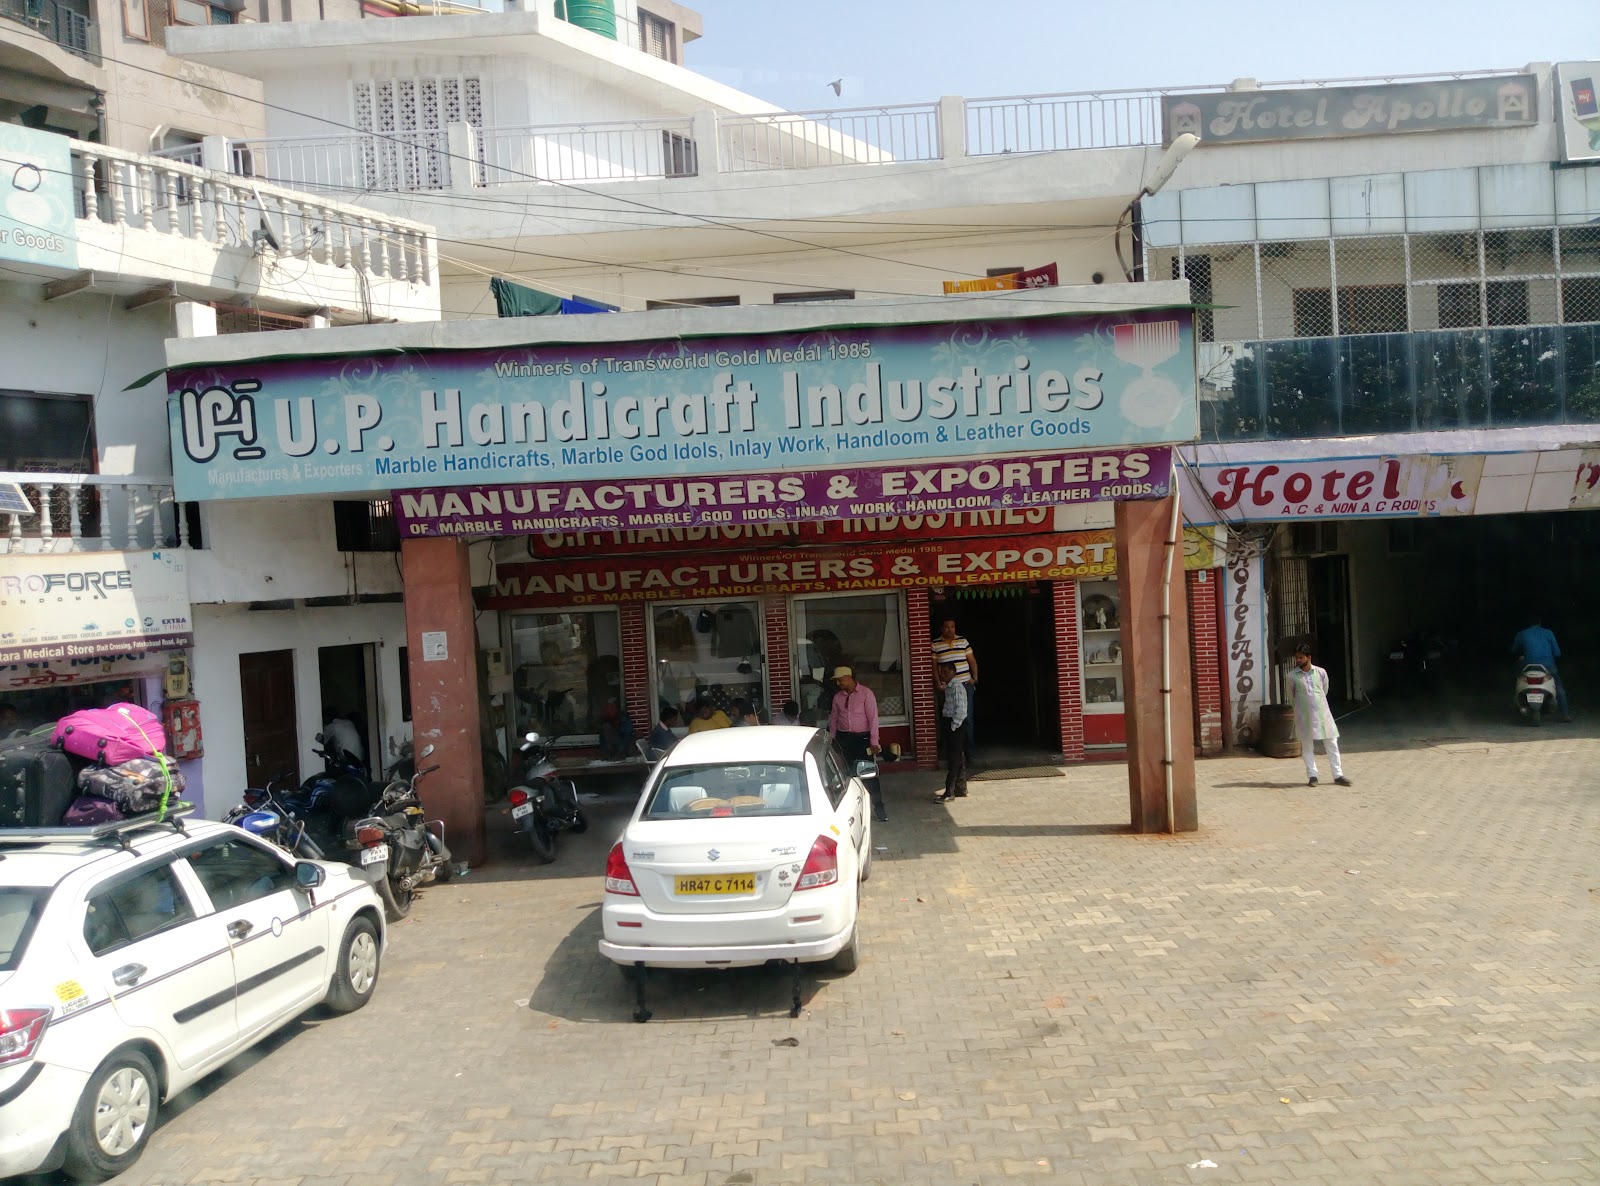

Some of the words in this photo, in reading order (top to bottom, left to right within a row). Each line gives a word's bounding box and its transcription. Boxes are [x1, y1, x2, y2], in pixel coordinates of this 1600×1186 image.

[1210, 96, 1328, 136] Hotel
[1342, 89, 1488, 130] Apollo
[12, 228, 64, 252] Goods
[495, 361, 573, 378] Winners
[580, 359, 599, 374] of
[603, 353, 709, 373] Transworld
[715, 350, 759, 367] Gold
[766, 346, 821, 365] Medal
[827, 342, 872, 360] 1985
[274, 395, 395, 458] U.P.
[421, 372, 758, 449] Handicraft
[783, 354, 1104, 430] Industries
[375, 456, 437, 475] Marble
[444, 449, 556, 472] Handicrafts,
[562, 446, 624, 466] Marble
[630, 443, 667, 462] God
[674, 440, 724, 461] Idols,
[730, 436, 772, 459] Inlay
[778, 433, 830, 454] Work,
[837, 428, 930, 450] Handloom
[935, 426, 949, 442] &
[954, 421, 1025, 442] Leather
[1031, 417, 1092, 437] Goods
[292, 464, 301, 480] &
[304, 463, 363, 480] Exporters
[400, 477, 806, 518] MANUFACTURERS
[827, 475, 858, 500] &
[882, 453, 1150, 496] EXPORTERS
[1212, 459, 1401, 510] Hotel
[410, 523, 429, 534] OF
[439, 520, 503, 534] MARBLE
[512, 515, 624, 531] HANDICRAFTS,
[629, 512, 692, 525] MARBLE
[701, 509, 732, 521] GOD
[796, 505, 839, 517] INLAY
[906, 496, 991, 512] HANDLOOM
[1003, 493, 1013, 505] &
[1023, 488, 1091, 504] LEATHER
[1101, 483, 1152, 497] GOODS
[1314, 503, 1324, 514] &
[1331, 503, 1357, 514] NON
[489, 556, 875, 597] MANUFACTURERS
[891, 555, 921, 576] &
[573, 594, 595, 604] OF
[956, 569, 1041, 584] LEATHER
[1051, 563, 1115, 578] GOODS
[24, 646, 64, 660] Medical
[67, 645, 95, 656] Store
[680, 880, 711, 892] HR47
[714, 880, 722, 891] C
[726, 879, 753, 890] 7114
